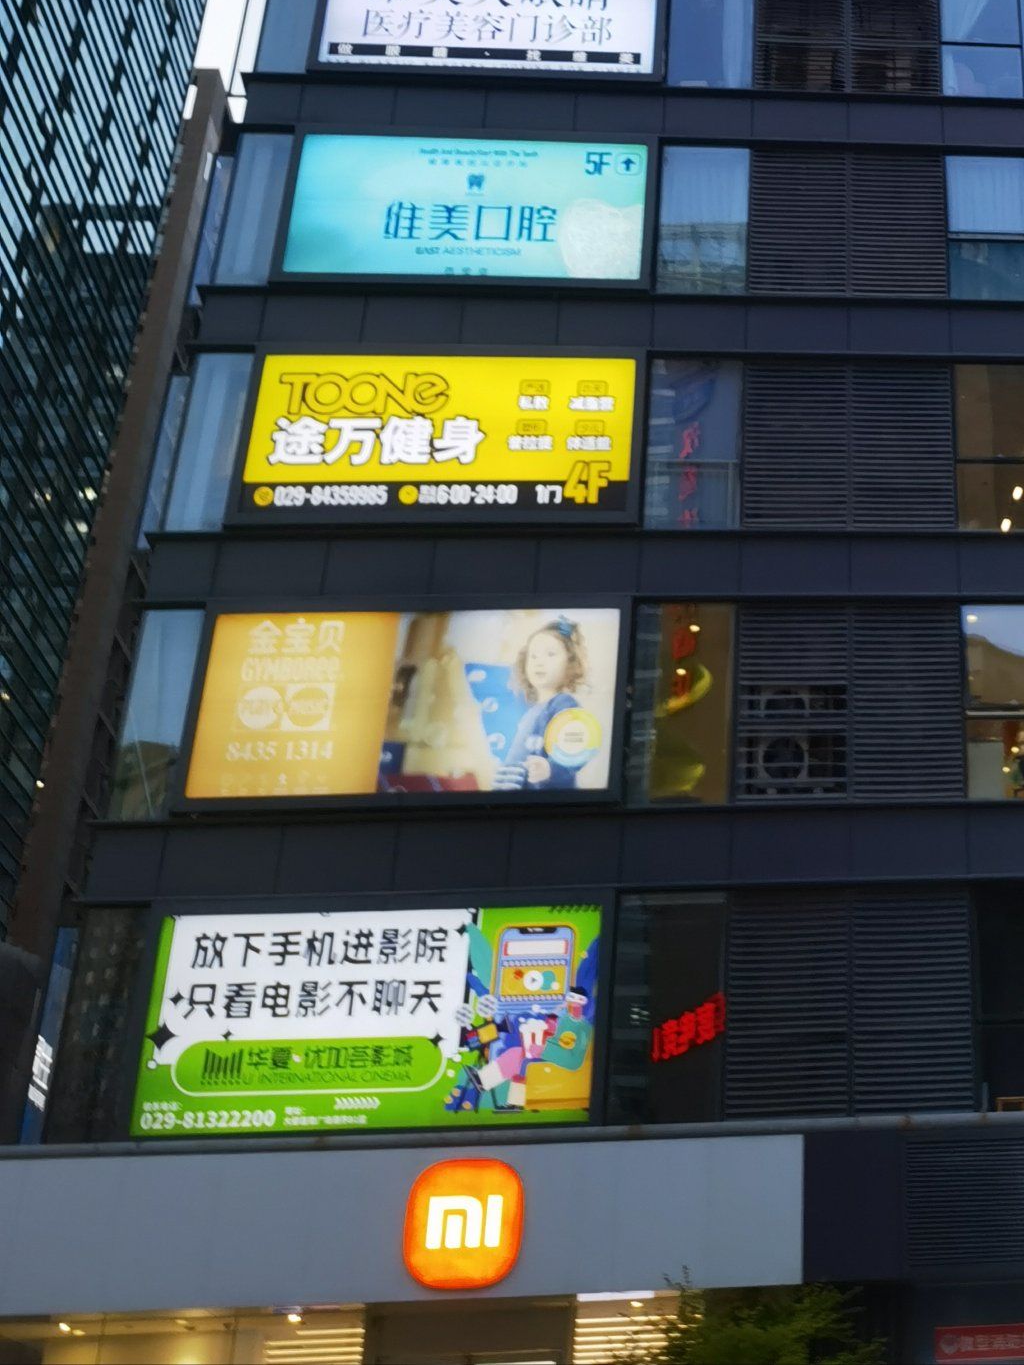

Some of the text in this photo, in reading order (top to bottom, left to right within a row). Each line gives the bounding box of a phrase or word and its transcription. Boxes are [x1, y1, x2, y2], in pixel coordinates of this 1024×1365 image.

[362, 8, 612, 46] 医疗美容门诊部
[585, 151, 614, 175] 5F
[267, 415, 486, 465] 途万健身
[563, 460, 611, 504] 4F
[248, 617, 345, 654] 金宝贝
[226, 740, 334, 762] 8435 1314
[190, 927, 449, 969] 放下手机进影院
[182, 980, 443, 1019] 只看电影不聊天
[140, 1109, 276, 1130] 029-81322200
